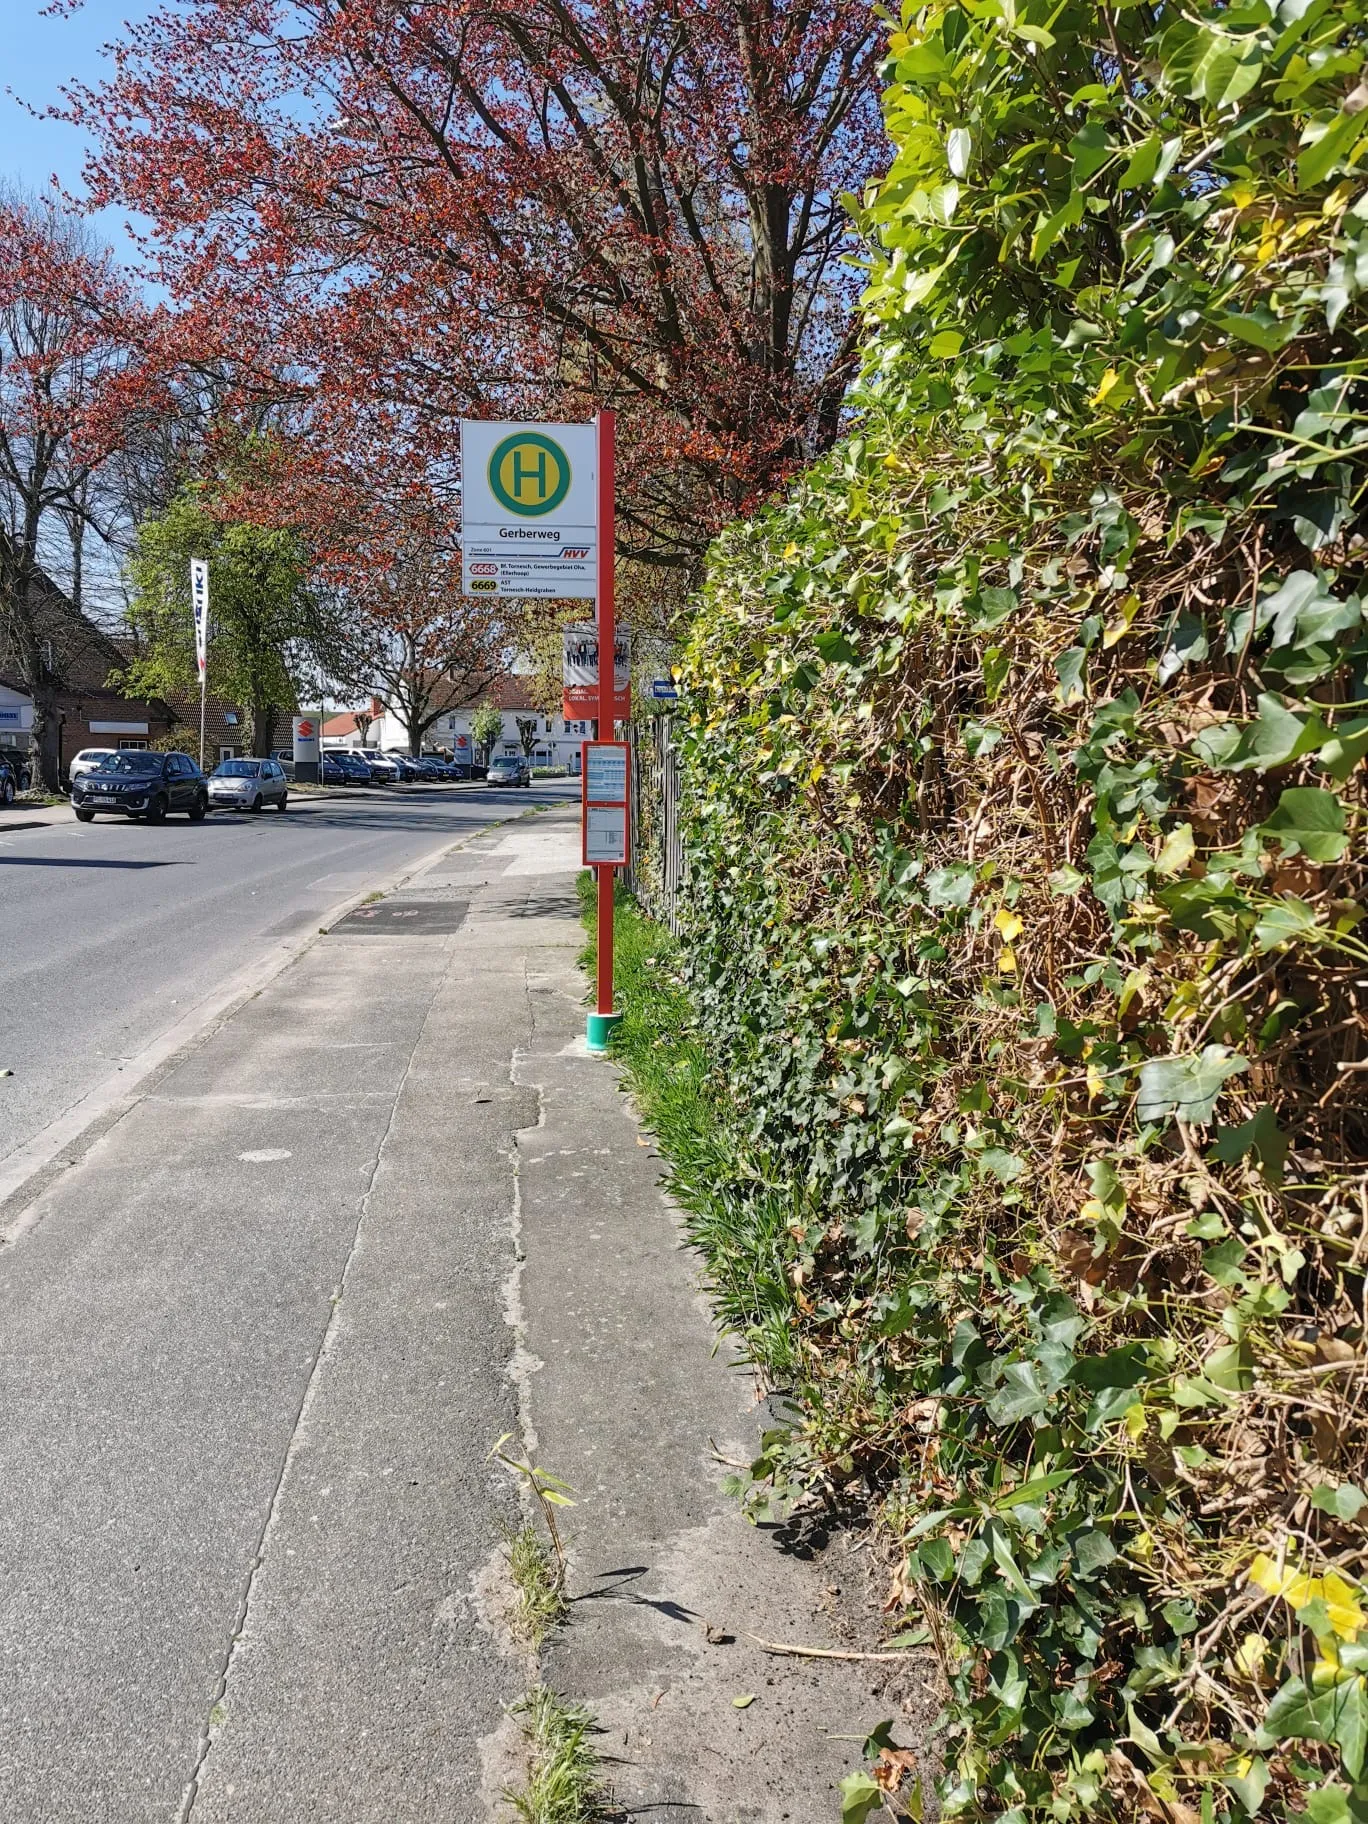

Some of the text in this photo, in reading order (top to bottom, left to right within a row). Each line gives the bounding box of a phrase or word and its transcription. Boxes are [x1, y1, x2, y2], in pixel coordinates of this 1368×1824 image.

[499, 528, 560, 541] Gerberweg
[563, 550, 589, 558] HVV
[471, 564, 497, 574] 6668
[471, 581, 497, 590] 6669
